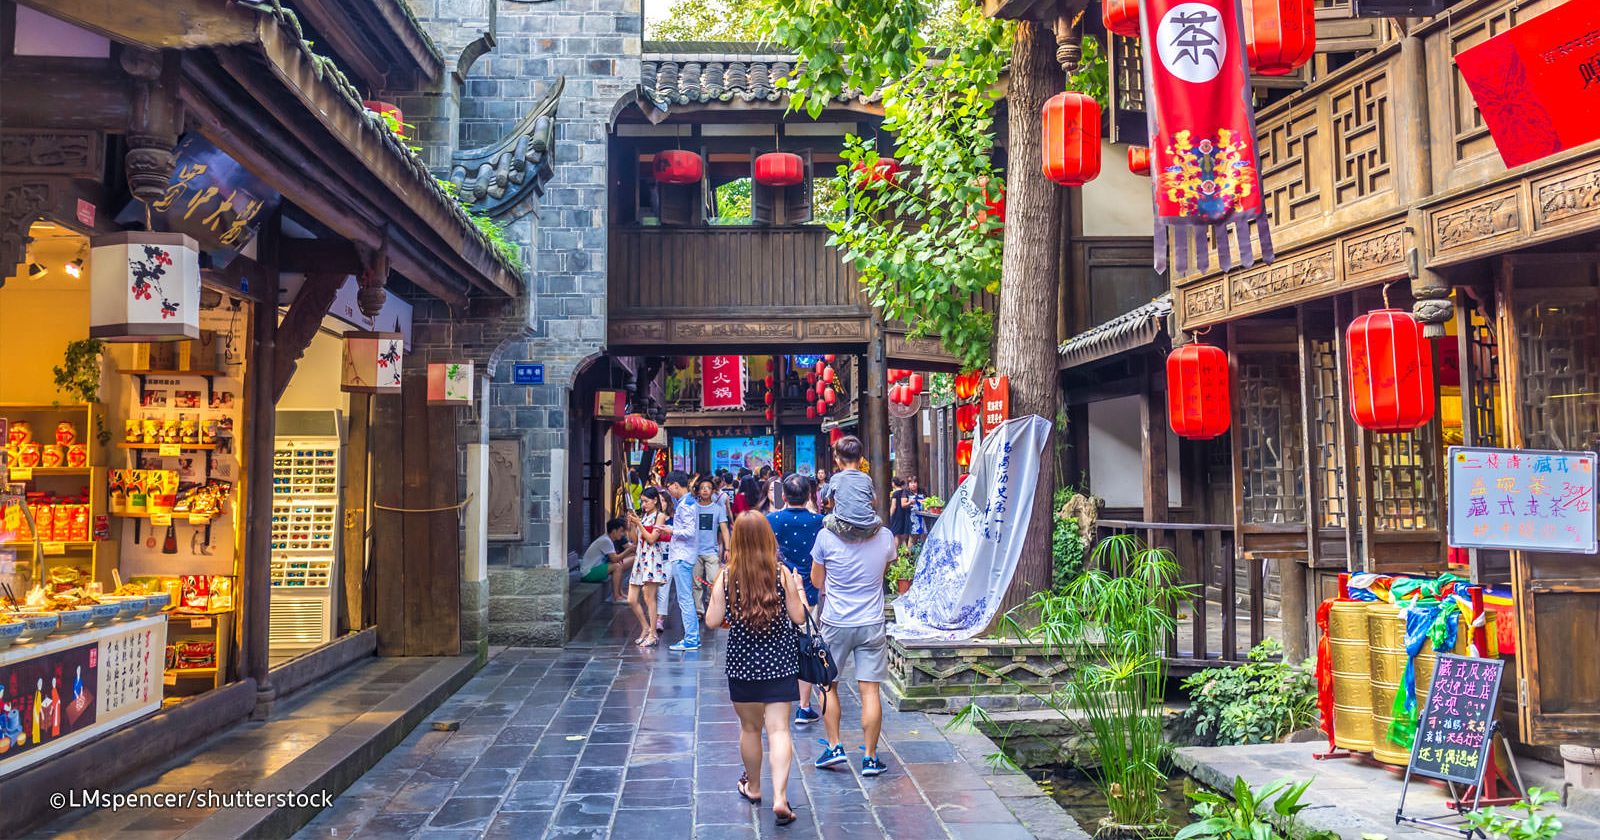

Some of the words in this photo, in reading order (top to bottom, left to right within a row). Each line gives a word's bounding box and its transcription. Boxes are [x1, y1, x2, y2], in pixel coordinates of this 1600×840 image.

[1170, 11, 1220, 71] 茶
[1438, 658, 1498, 682] 藏式风格
[1434, 677, 1491, 701] 欢迎进店
[1430, 693, 1460, 716] 参观
